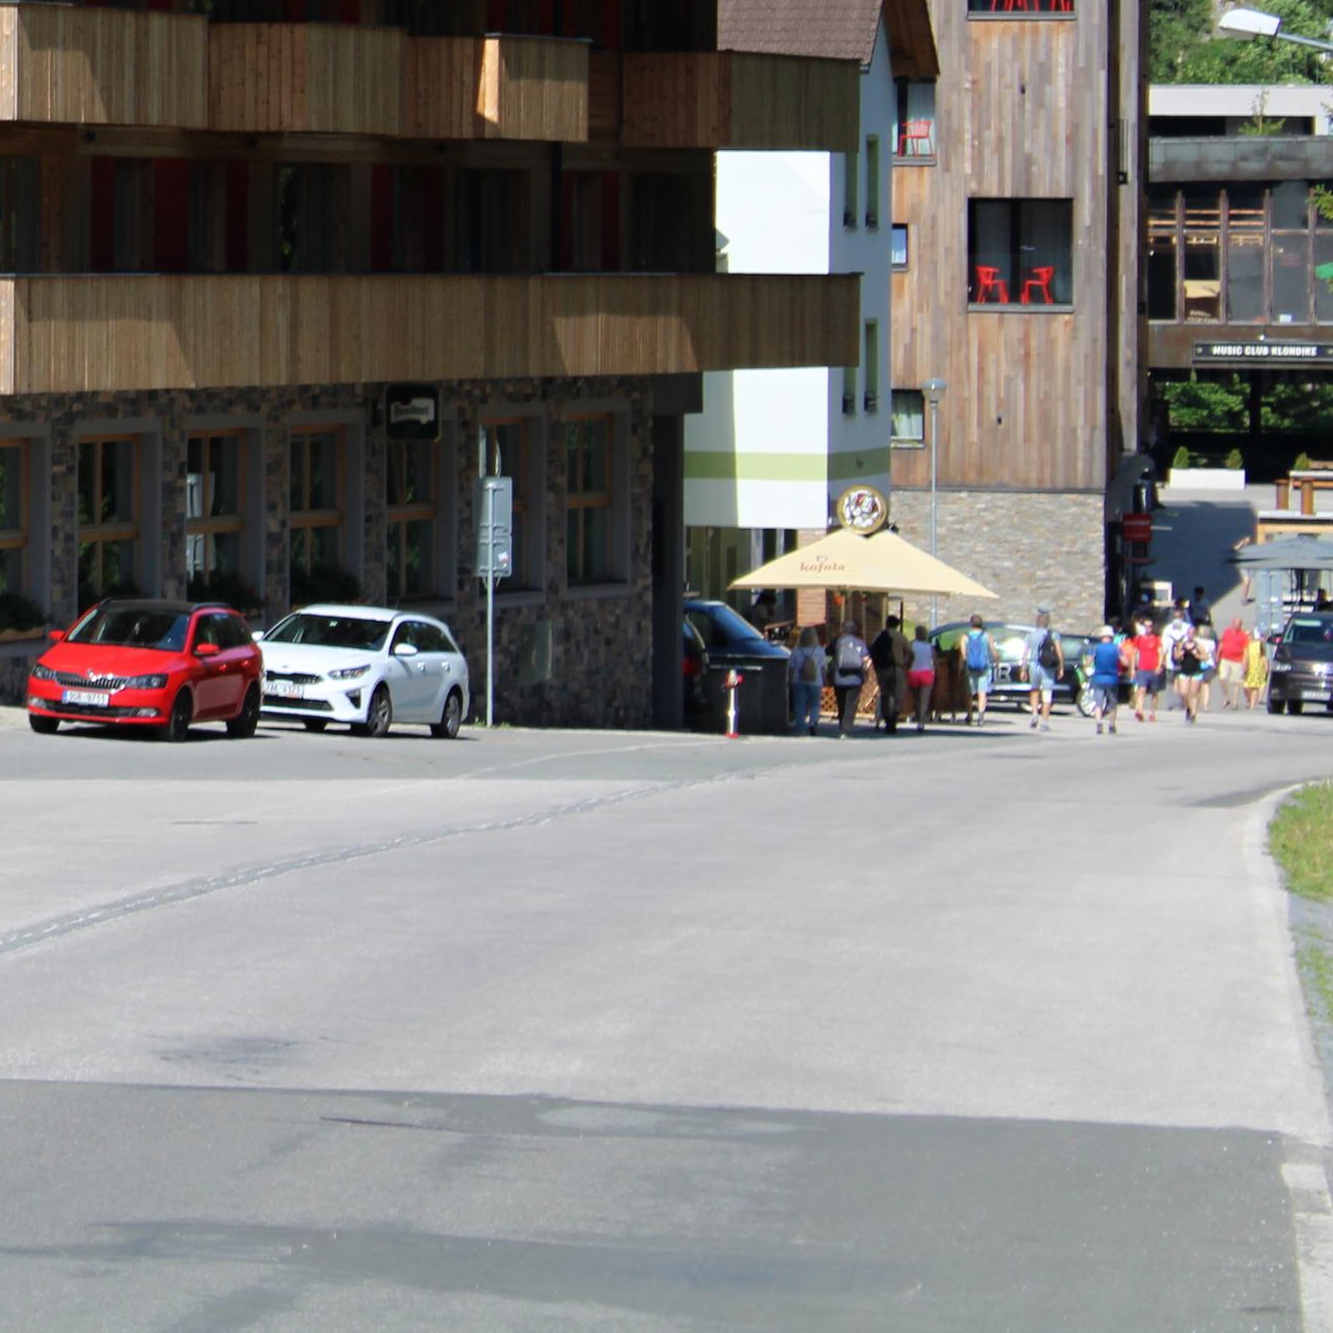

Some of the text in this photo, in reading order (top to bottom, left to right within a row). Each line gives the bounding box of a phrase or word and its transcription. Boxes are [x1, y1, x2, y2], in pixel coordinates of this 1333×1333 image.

[1212, 345, 1318, 357] MUSIC CLUB KLONDIKE
